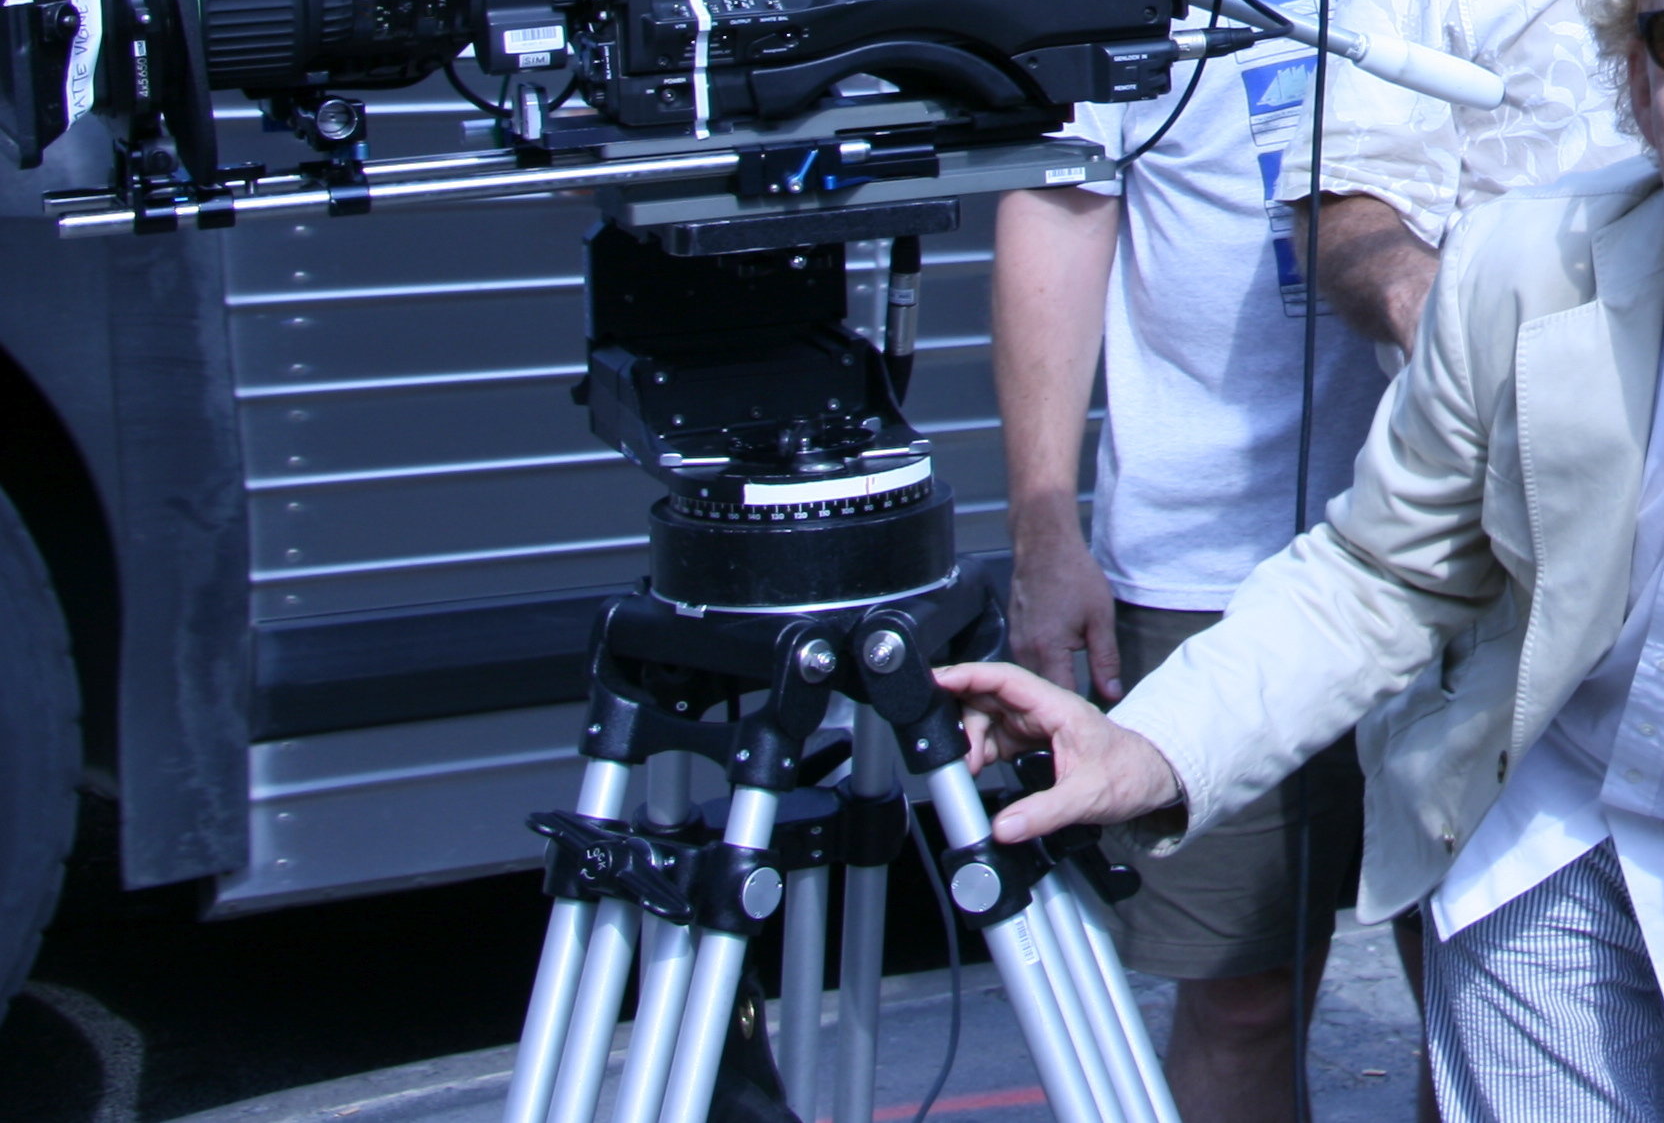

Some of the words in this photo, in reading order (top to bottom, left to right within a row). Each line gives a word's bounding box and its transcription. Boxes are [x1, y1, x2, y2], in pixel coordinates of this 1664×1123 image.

[523, 55, 546, 65] SIM
[663, 77, 687, 85] POWER
[771, 512, 785, 520] 130
[794, 511, 809, 520] 120
[819, 509, 831, 517] 110
[841, 507, 855, 515] 100
[586, 847, 607, 870] LOCK
